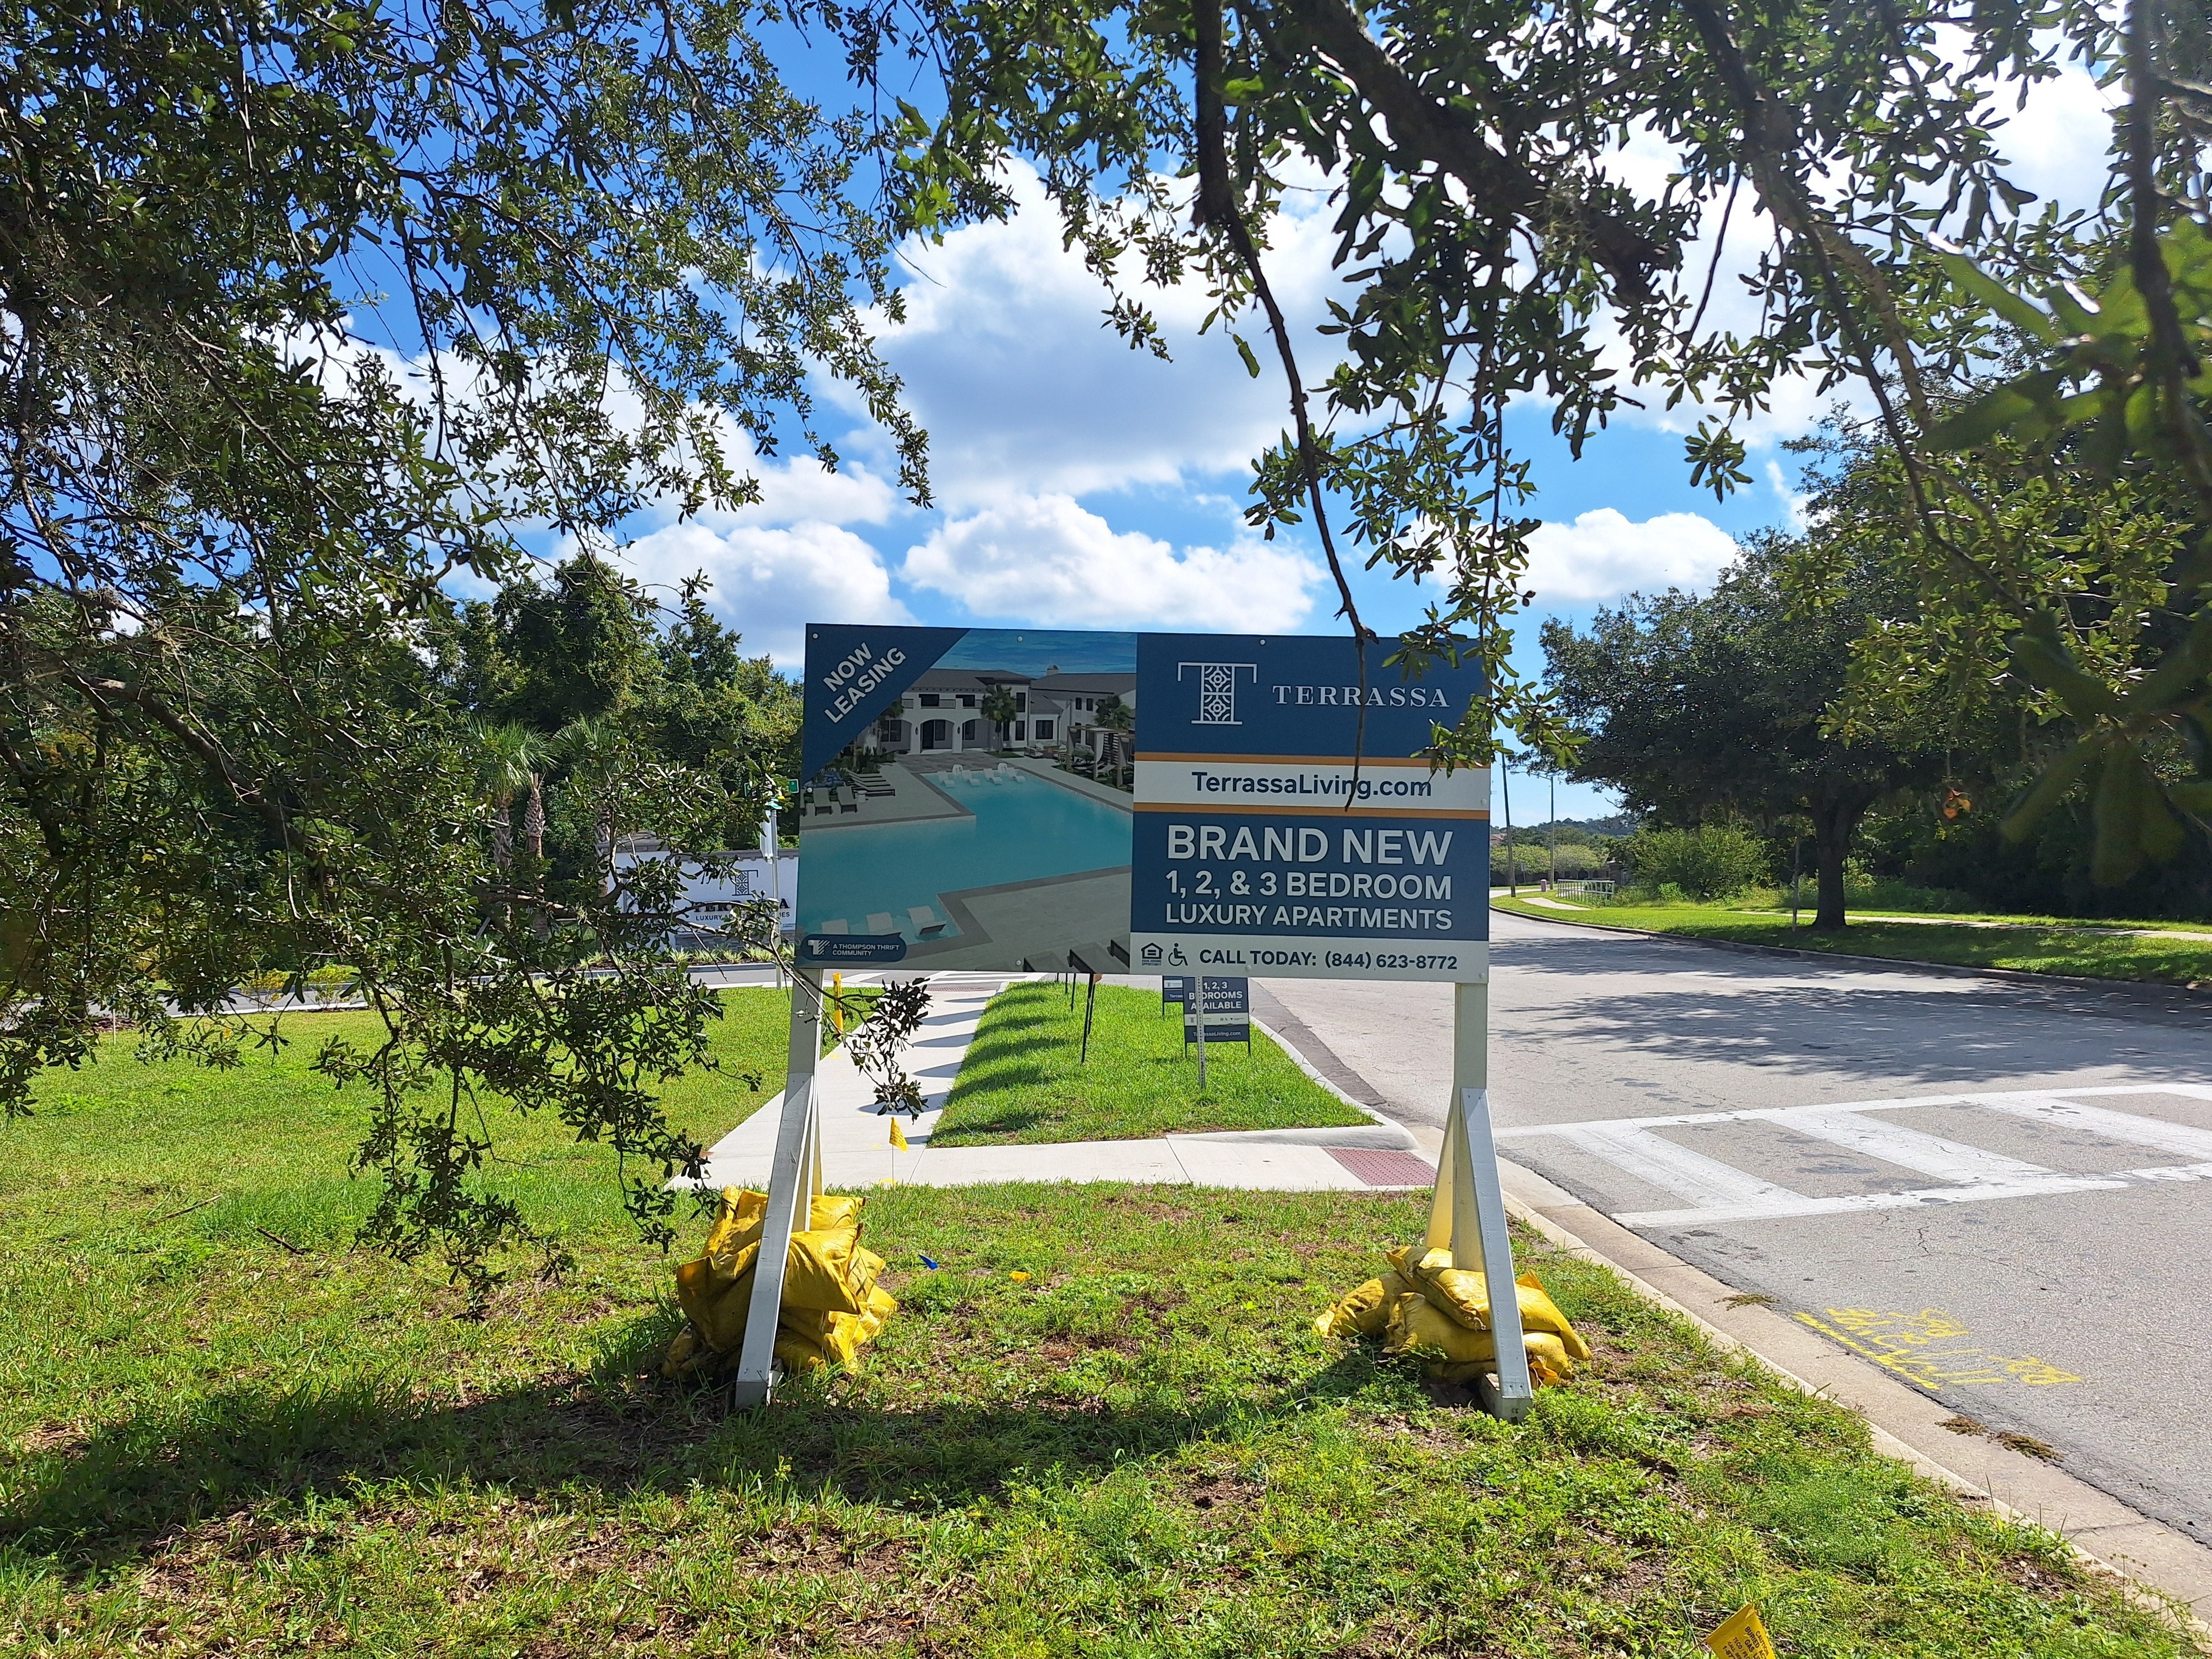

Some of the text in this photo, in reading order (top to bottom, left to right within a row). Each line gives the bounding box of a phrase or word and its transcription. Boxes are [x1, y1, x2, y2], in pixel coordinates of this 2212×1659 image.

[823, 642, 872, 692] NOW
[824, 647, 906, 723] LEASING
[1272, 685, 1450, 708] TERRASSA
[1192, 771, 1432, 800] TerrassaLiving.com
[1167, 824, 1454, 866] BRAND NEW
[1165, 870, 1452, 901] 1, 2, & 3 BEDROOM
[694, 898, 790, 913] TERA
[1166, 903, 1453, 930] LUXURY APARTMENTS
[1199, 949, 1457, 970] CALL TODAY: (844) 623-8772
[1188, 991, 1243, 1000] BDROOMS
[1203, 982, 1210, 991] 1,
[1212, 982, 1220, 991] 2,
[1191, 1001, 1242, 1010] AAILABLE
[1744, 1626, 1760, 1648] BURIED
[1745, 1639, 1755, 1652] GAS
[1756, 1630, 1769, 1656] CAUTION
